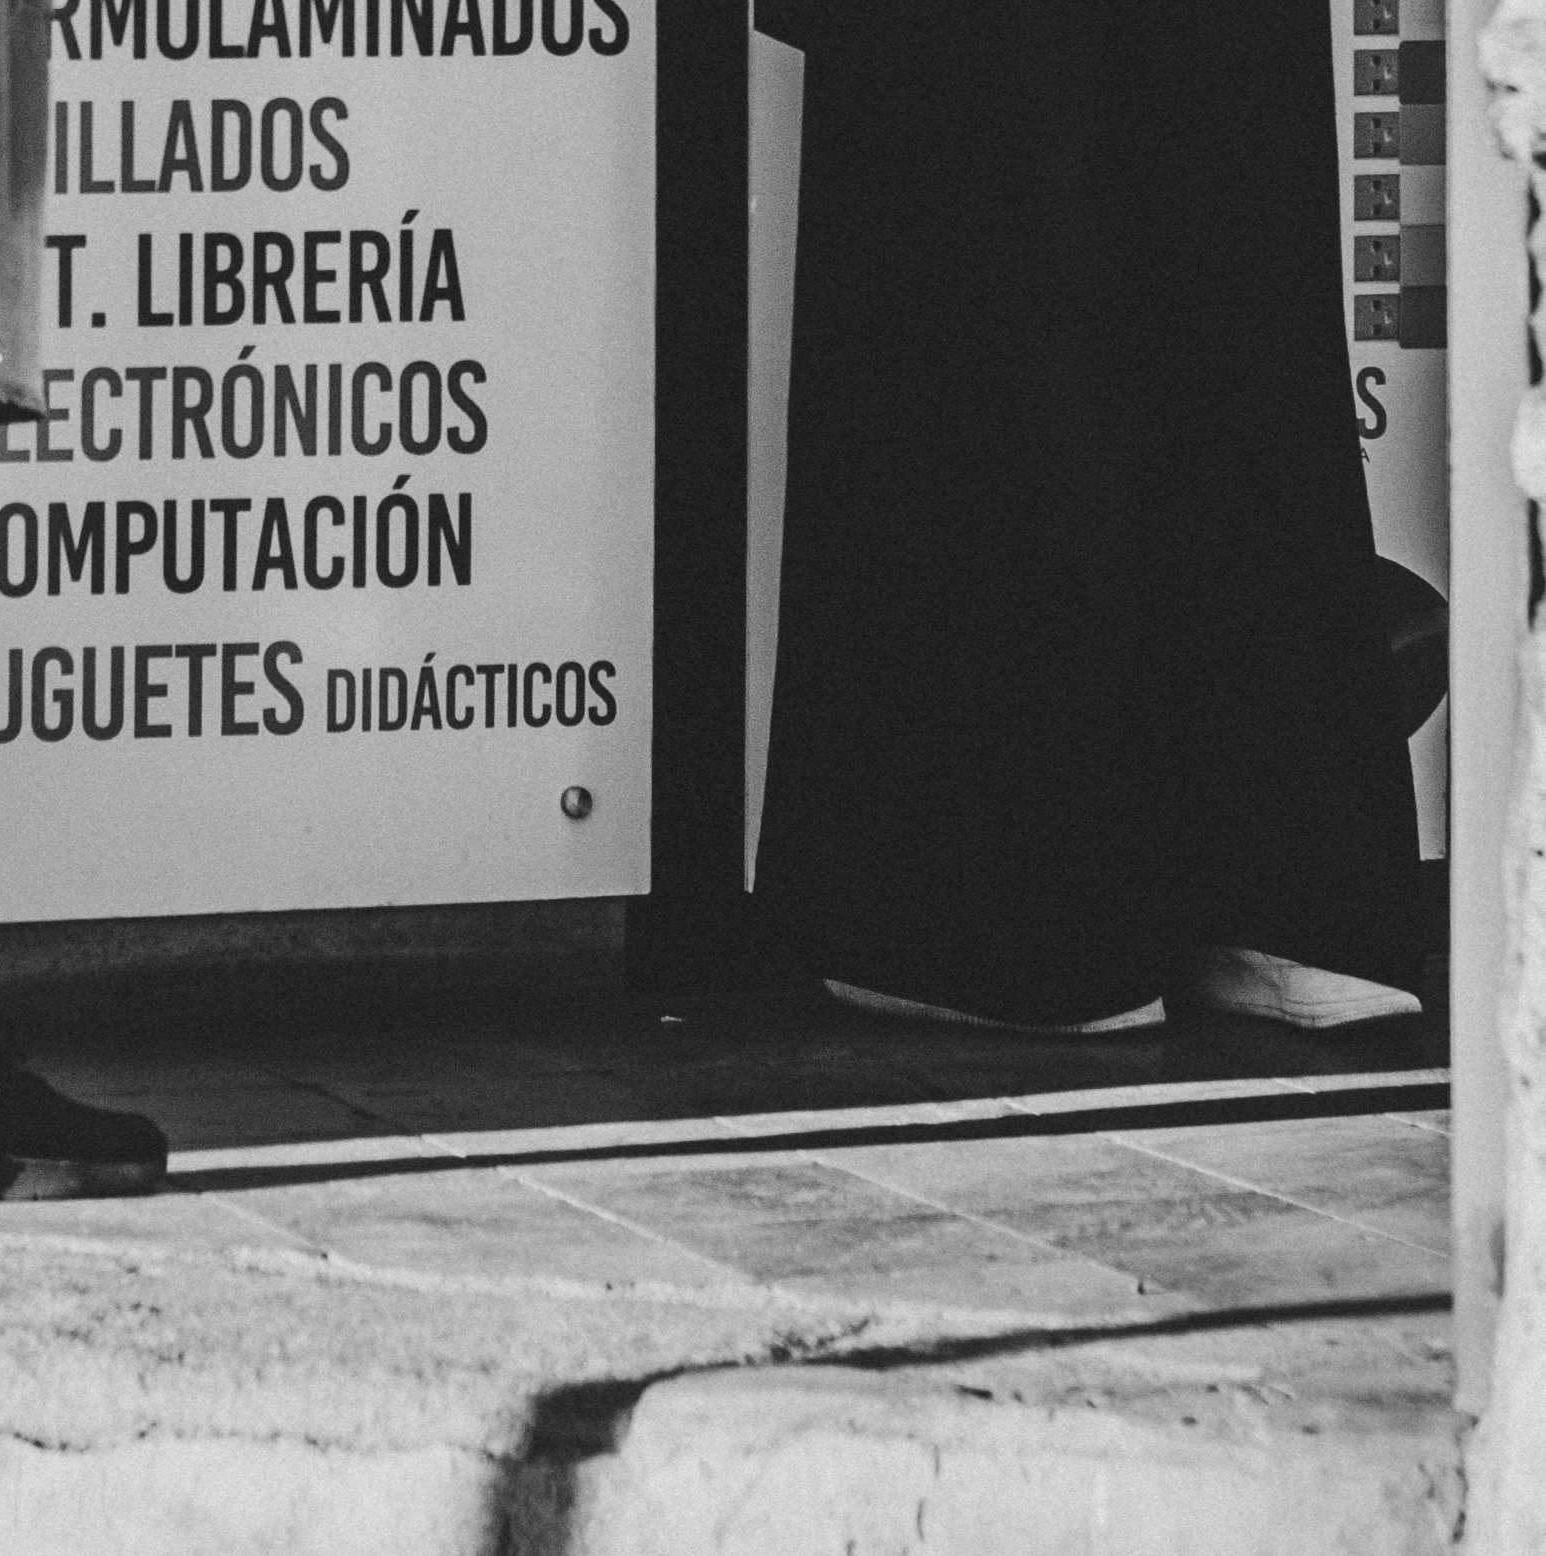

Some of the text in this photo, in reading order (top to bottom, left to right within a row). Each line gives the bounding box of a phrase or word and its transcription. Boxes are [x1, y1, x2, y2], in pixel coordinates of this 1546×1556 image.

[55, 97, 350, 194] ILLADOS
[45, 210, 466, 329] T. LIBRERÍA
[326, 652, 618, 734] DIDÁCTICOS
